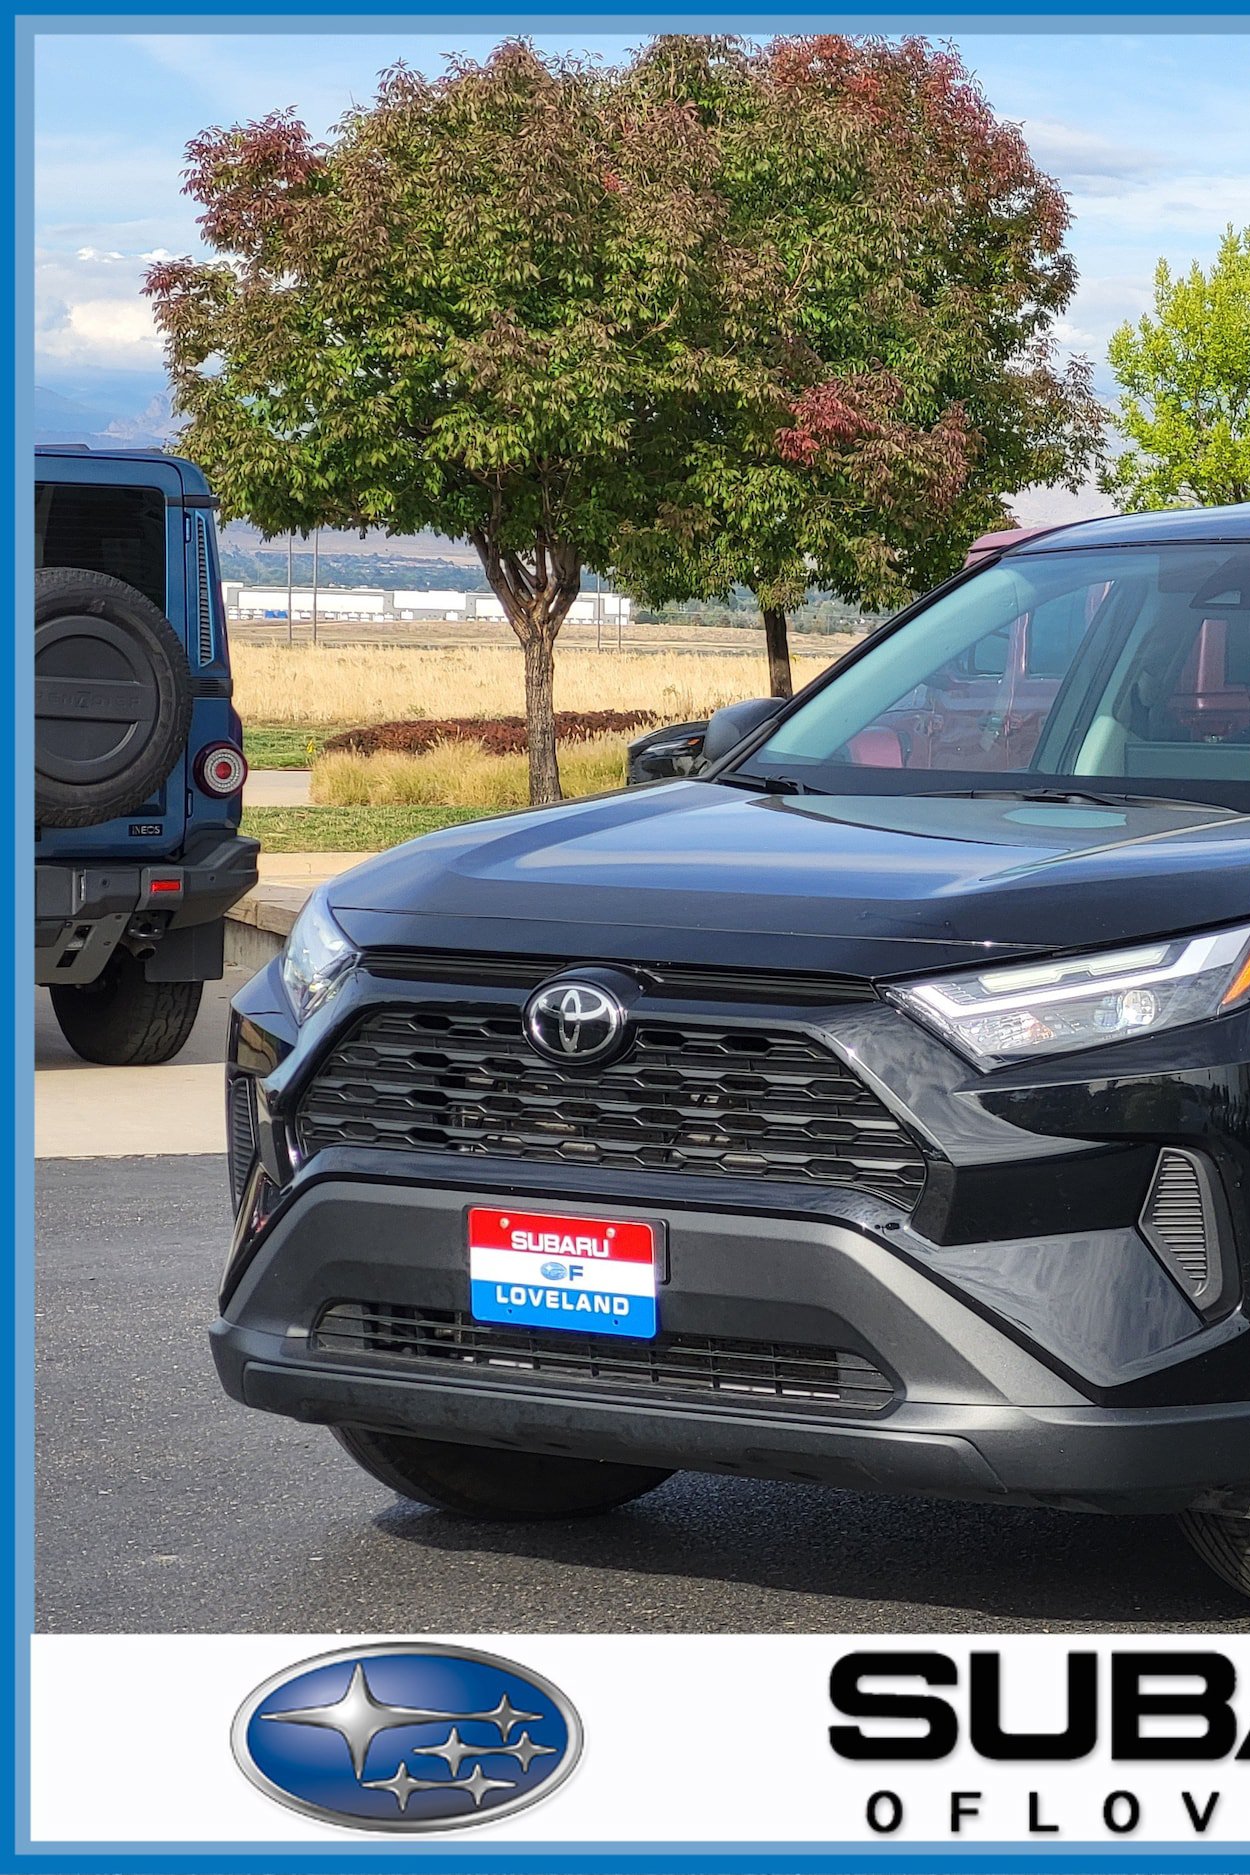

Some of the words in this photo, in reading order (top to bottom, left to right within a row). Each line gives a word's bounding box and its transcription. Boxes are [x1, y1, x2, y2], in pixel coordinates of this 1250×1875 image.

[131, 825, 161, 835] INEOS
[510, 1230, 610, 1259] SUBARU
[496, 1284, 630, 1317] LOVELAND
